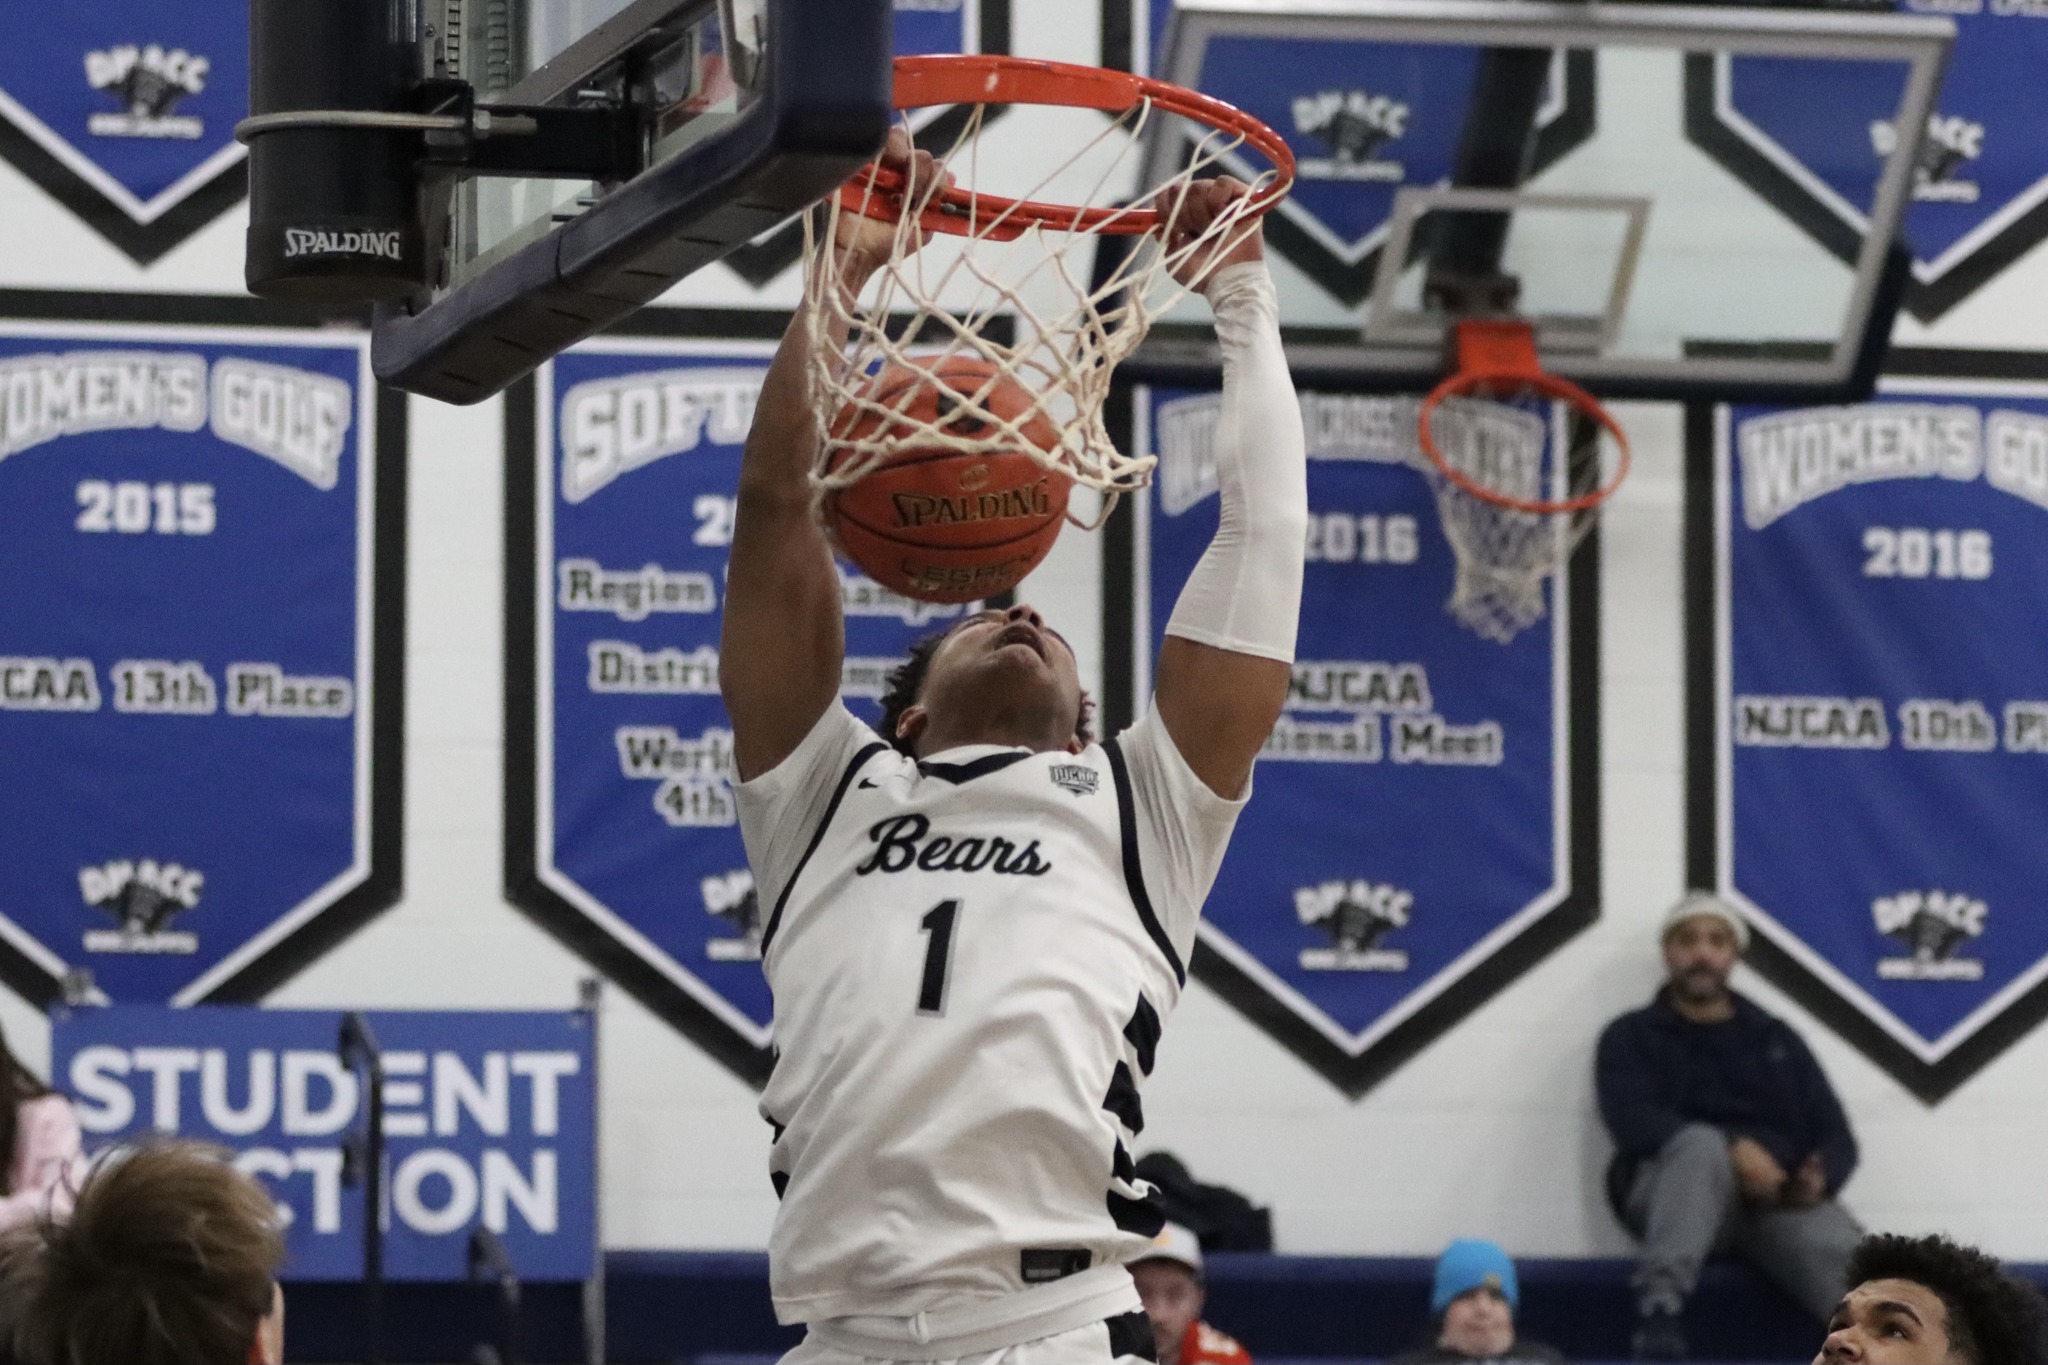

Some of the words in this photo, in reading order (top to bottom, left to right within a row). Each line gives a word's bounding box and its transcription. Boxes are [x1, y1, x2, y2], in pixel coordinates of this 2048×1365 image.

[285, 229, 401, 259] SPALDING
[0, 356, 203, 453] OMEN'S
[215, 364, 346, 483] GOLF
[567, 373, 768, 495] SOFT
[76, 480, 216, 535] 2015
[891, 478, 1049, 529] SPALDING
[1863, 526, 1993, 580] 2016
[564, 562, 710, 615] Region
[116, 663, 211, 709] 13th
[231, 667, 348, 713] Place
[594, 644, 720, 690] Distri
[1396, 719, 1499, 759] Meet
[1740, 700, 1884, 744] NJCAA
[1904, 705, 1990, 746] 10th
[621, 731, 733, 774] Worl
[659, 781, 732, 822] 4th
[856, 813, 1052, 876] Bears
[917, 899, 965, 1017] 1
[70, 1045, 579, 1136] STUDENT
